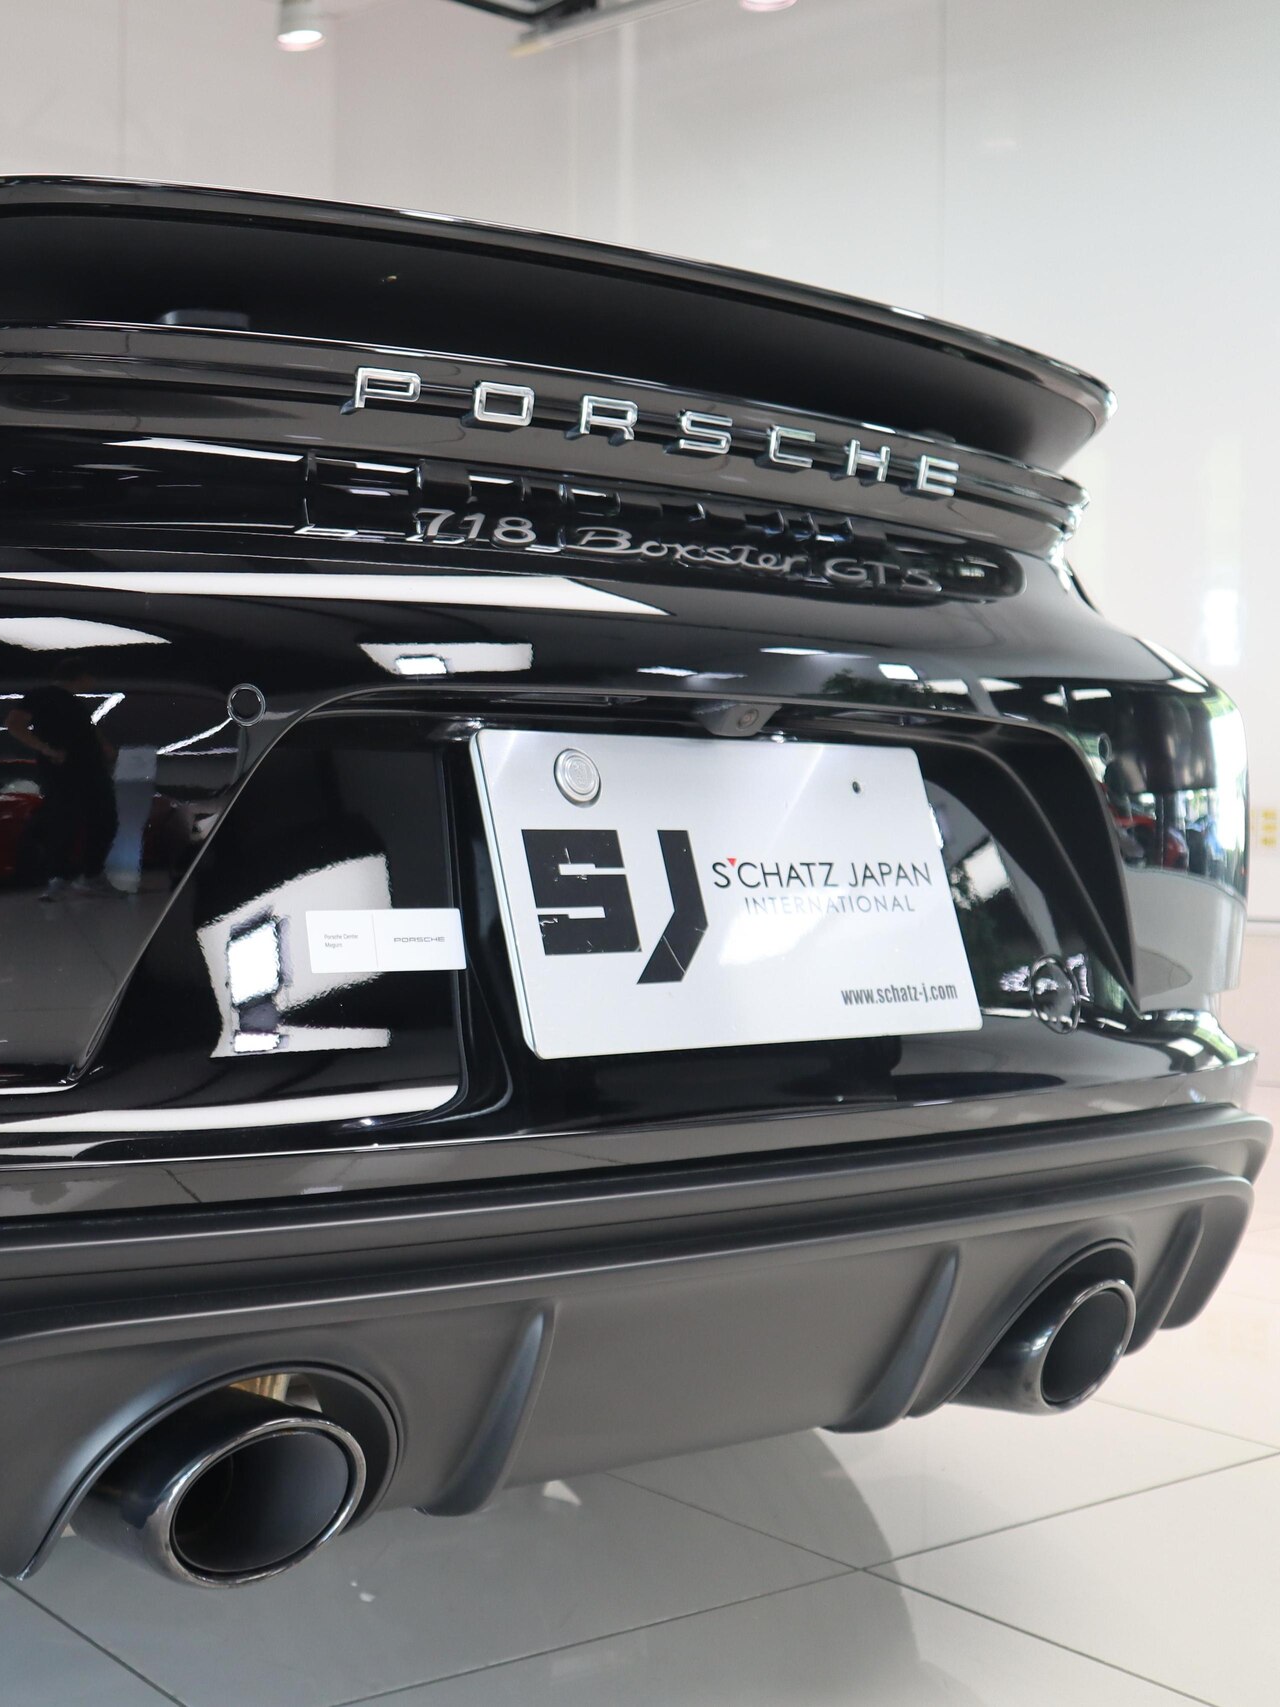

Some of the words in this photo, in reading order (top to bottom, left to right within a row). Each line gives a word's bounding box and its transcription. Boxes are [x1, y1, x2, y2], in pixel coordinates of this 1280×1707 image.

[352, 366, 960, 497] PORSCHE
[415, 507, 537, 547] 718
[562, 526, 809, 574] Boxster
[824, 557, 943, 593] GTS
[848, 862, 933, 888] JAPAN
[745, 895, 916, 915] INTERNATIONAL
[841, 983, 958, 1006] www.schatz-j.com
